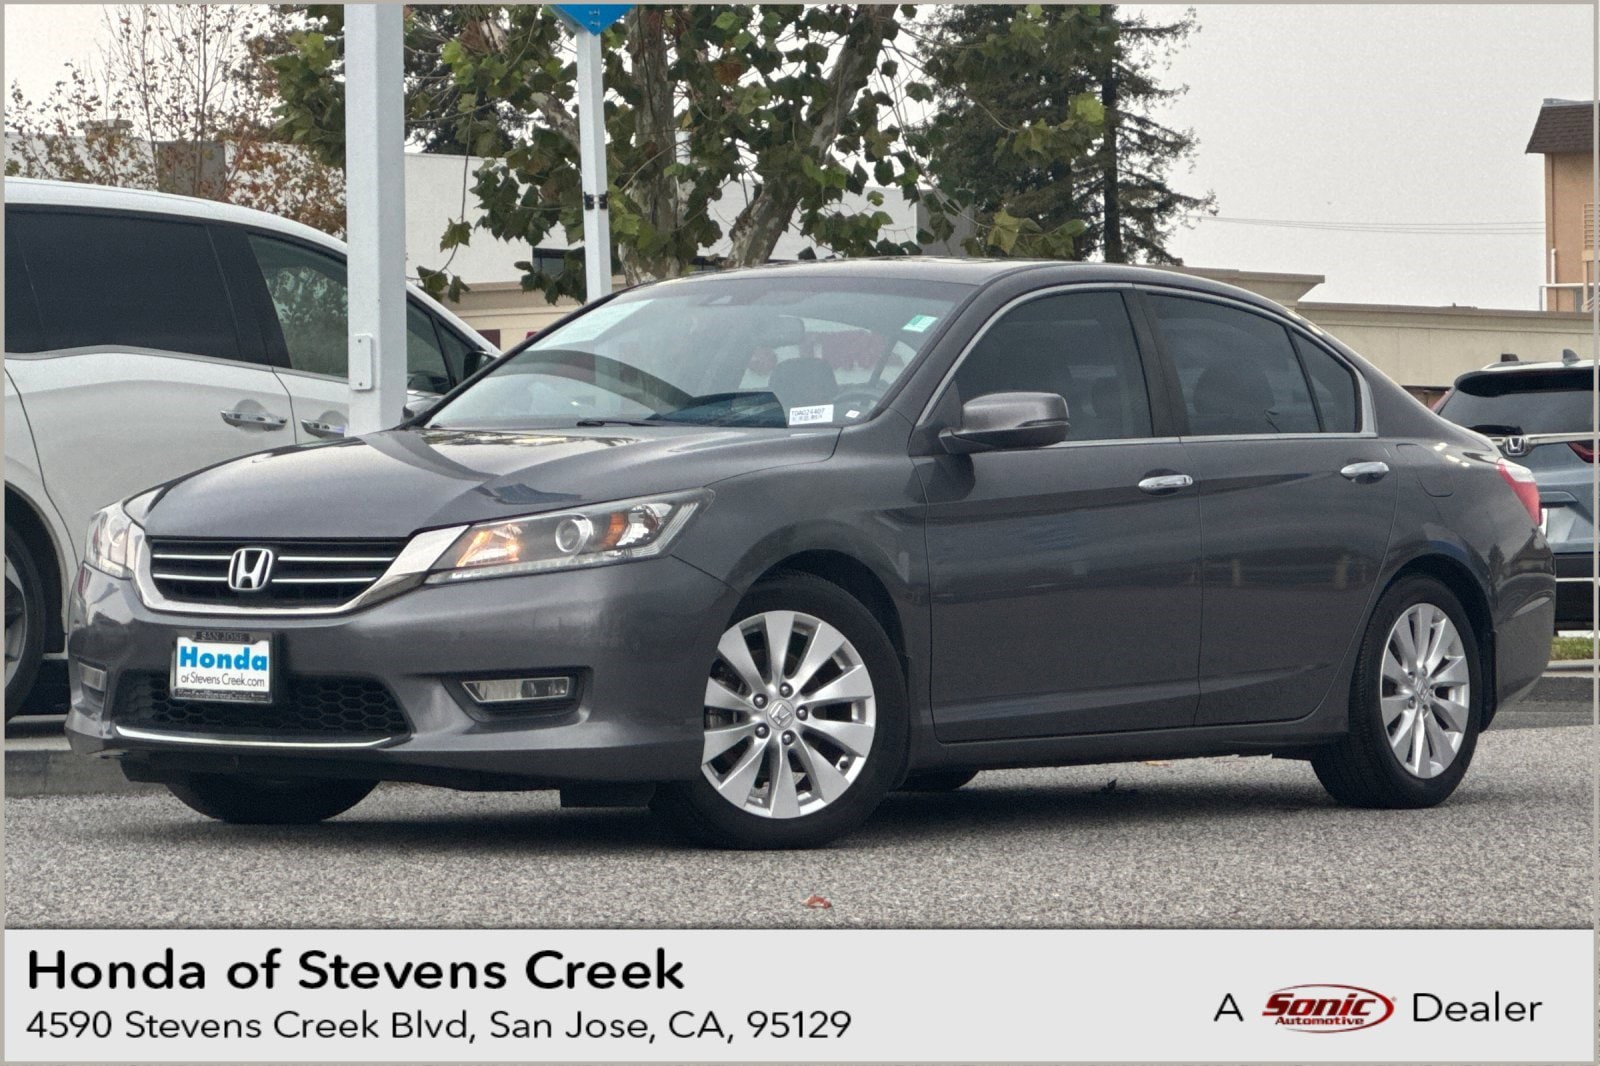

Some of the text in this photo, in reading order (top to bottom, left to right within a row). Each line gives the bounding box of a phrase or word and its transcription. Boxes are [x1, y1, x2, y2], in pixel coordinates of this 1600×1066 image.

[180, 646, 268, 671] Honda
[181, 671, 265, 687] of Stevens Creek.com
